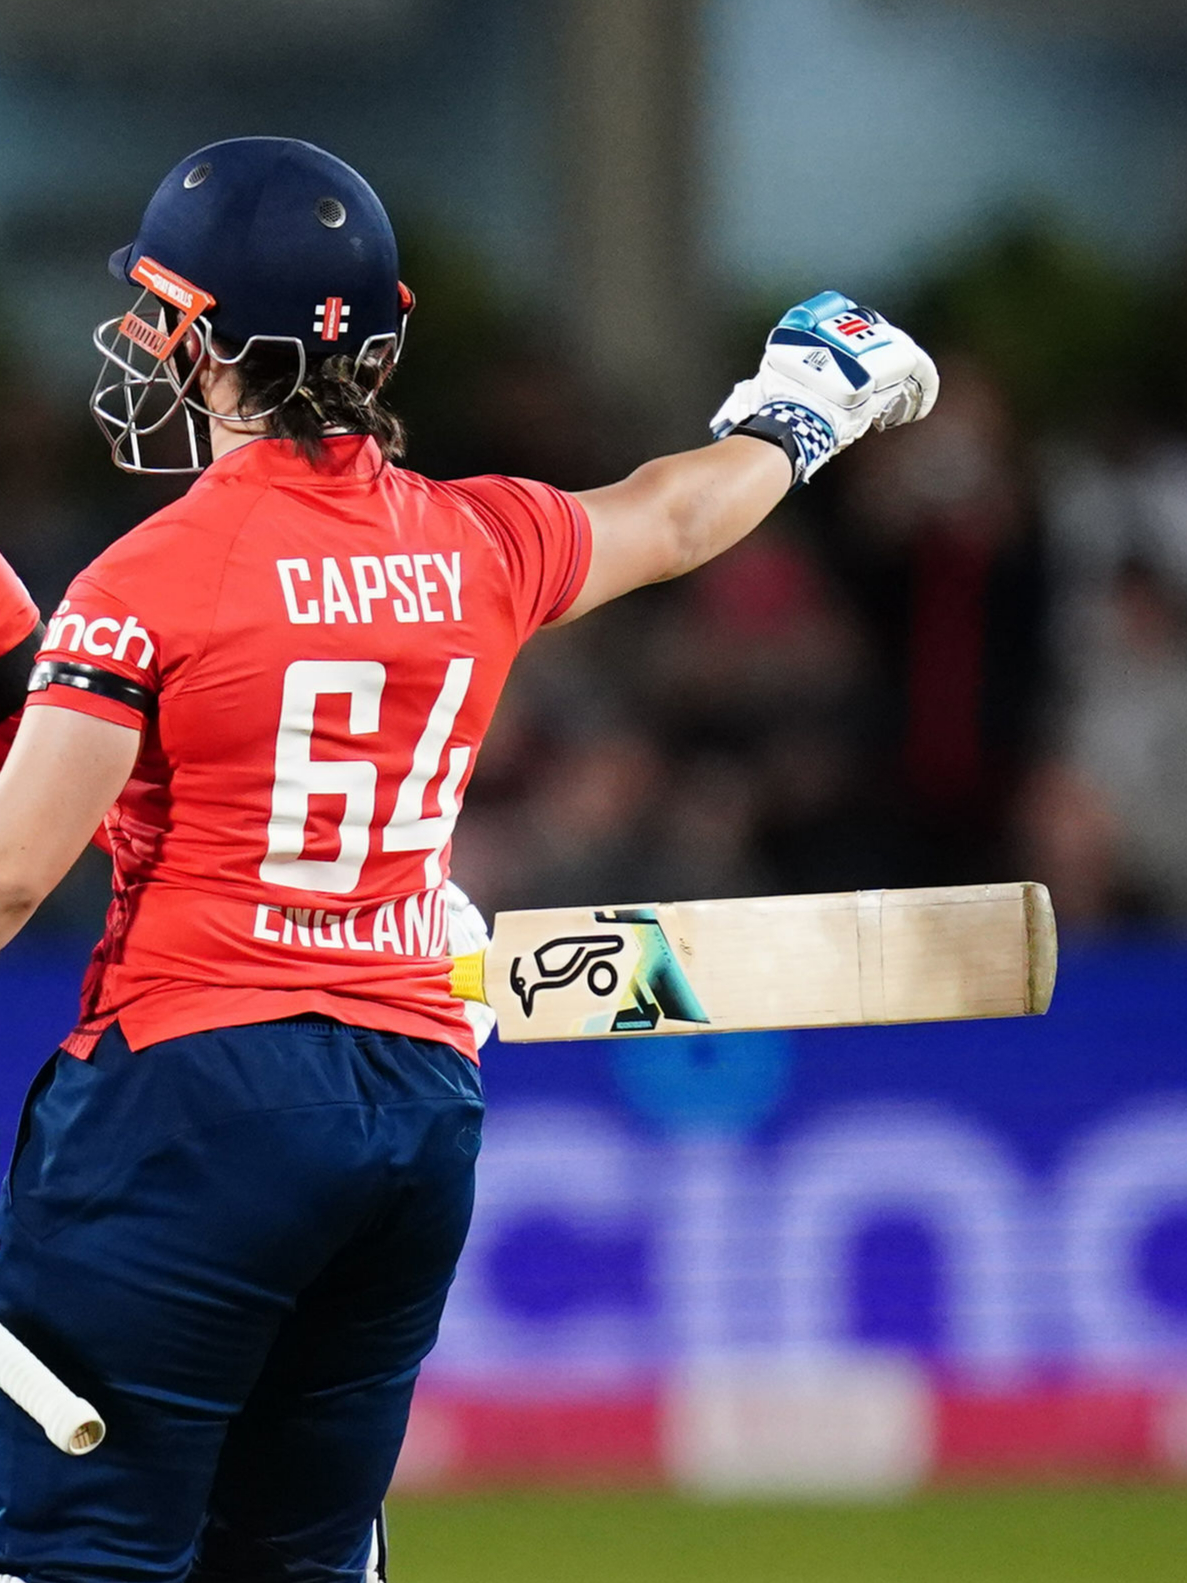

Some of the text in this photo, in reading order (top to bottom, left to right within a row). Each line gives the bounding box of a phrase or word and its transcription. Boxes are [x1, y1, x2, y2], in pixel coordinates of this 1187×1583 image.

[277, 552, 463, 624] CAPSEY
[40, 599, 155, 670] inch
[259, 657, 475, 894] 64
[253, 889, 448, 957] ENGLAND
